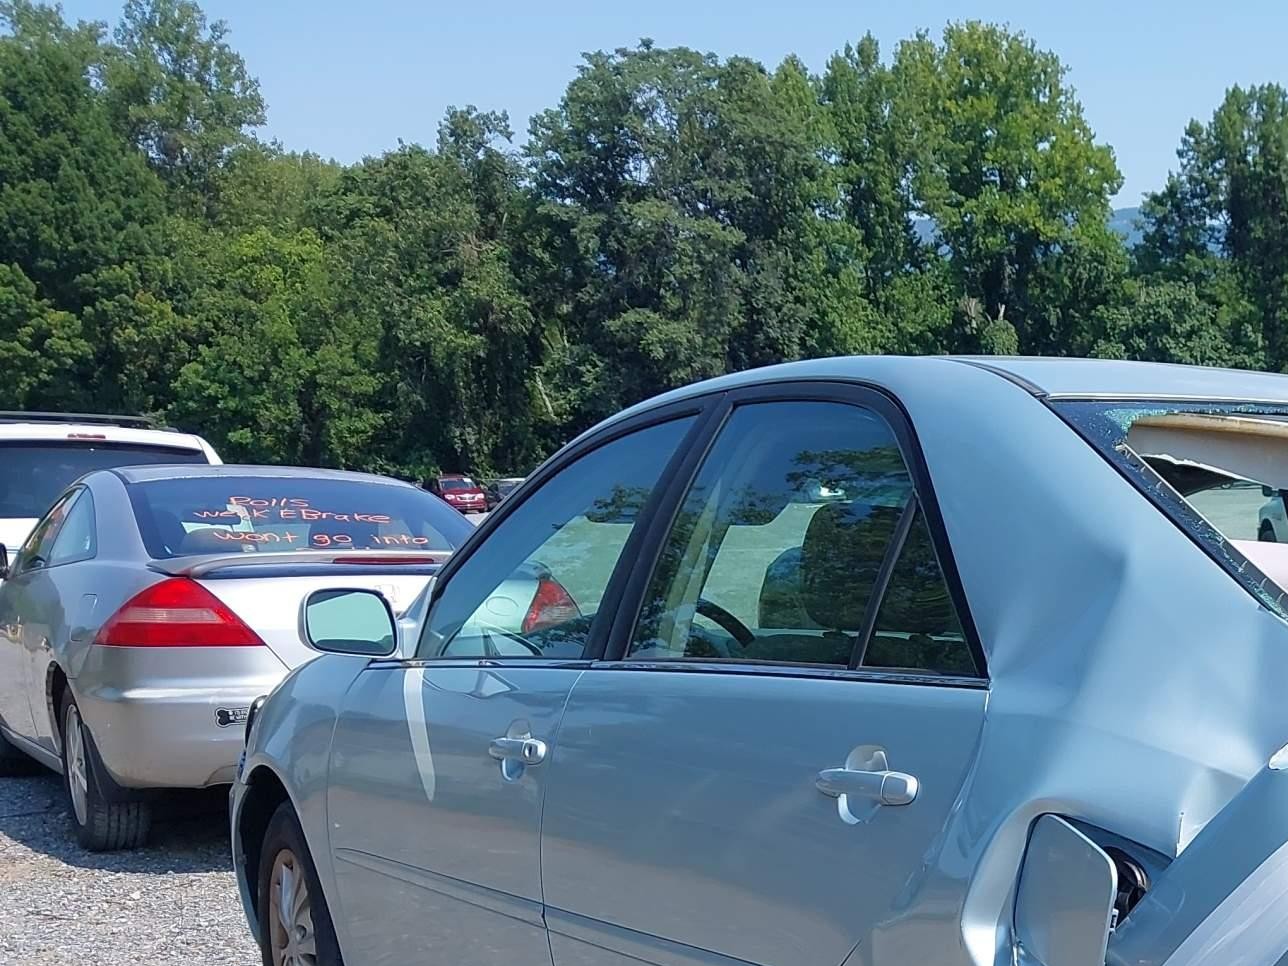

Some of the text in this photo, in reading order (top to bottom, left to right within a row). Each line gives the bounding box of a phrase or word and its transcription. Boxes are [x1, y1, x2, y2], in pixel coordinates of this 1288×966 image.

[229, 496, 309, 508] Rolls
[313, 534, 353, 547] go
[370, 533, 429, 545] into
